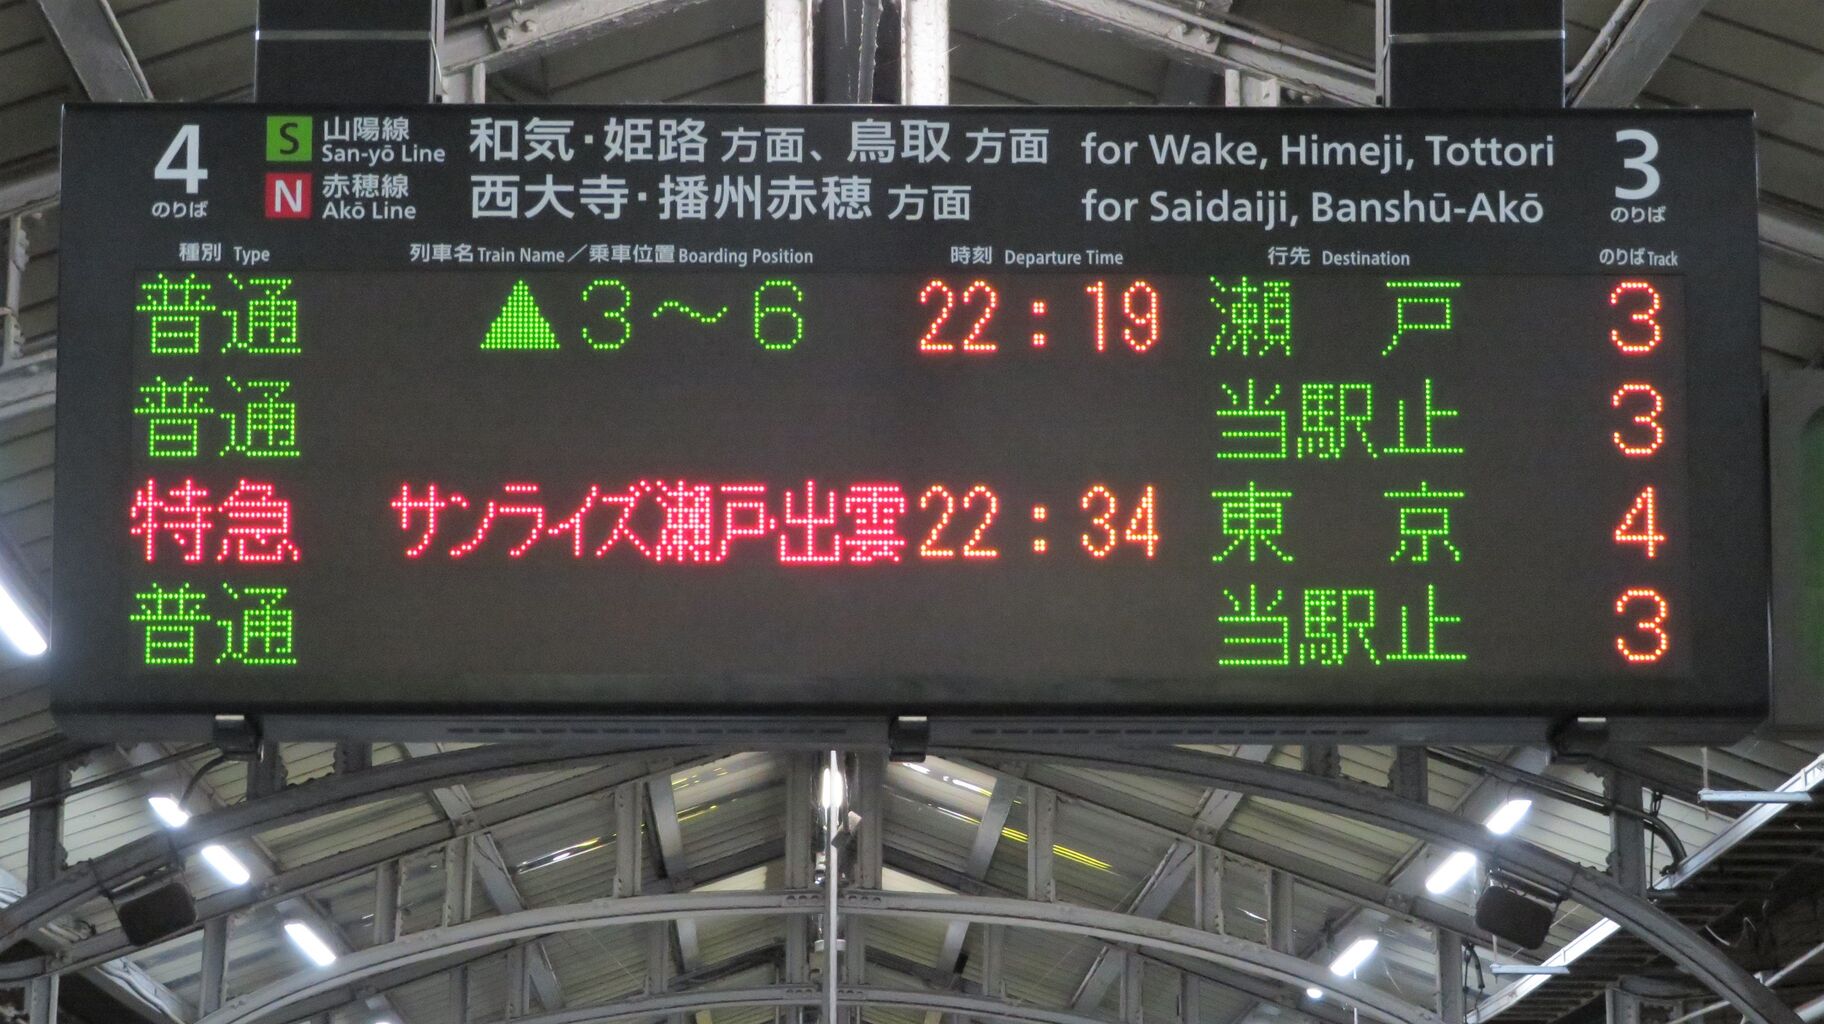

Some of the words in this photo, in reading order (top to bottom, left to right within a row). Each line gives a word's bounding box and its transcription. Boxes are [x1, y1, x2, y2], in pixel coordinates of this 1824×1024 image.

[280, 123, 299, 155] S
[324, 117, 409, 141] 山陽線
[154, 125, 208, 194] 4
[323, 145, 394, 166] San-yō
[402, 144, 445, 162] Line
[1081, 132, 1138, 164] for
[1149, 133, 1267, 169] Wake,
[1282, 134, 1413, 174] Himeji,
[1425, 135, 1553, 166] Tottori
[1615, 129, 1660, 200] 3
[274, 179, 303, 212] N
[323, 174, 408, 198] 赤穂線
[152, 201, 208, 218] のりば
[323, 200, 365, 219] Akō
[373, 201, 416, 219] Line
[1082, 189, 1138, 221] for
[1150, 190, 1298, 230] Saidaiji,
[1313, 190, 1543, 223] Banshū-Akō
[1611, 206, 1666, 222] のりば
[179, 243, 221, 261] 種別
[234, 247, 270, 265] Type
[410, 243, 473, 262] 列車名
[478, 248, 514, 262] Train
[679, 248, 747, 267] Boarding
[753, 249, 813, 263] Position
[951, 246, 992, 264] 時刻
[1005, 250, 1081, 268] Departure
[1086, 250, 1123, 264] Time
[1268, 247, 1310, 265] 行先
[1323, 251, 1409, 265] Destination
[1600, 248, 1645, 265] のりば
[1647, 251, 1678, 266] Track
[136, 273, 301, 353] 普通
[1609, 281, 1662, 354] 3
[134, 376, 300, 457] 普通
[1216, 378, 1463, 458] 当駅止
[1612, 383, 1664, 457] 3
[130, 479, 300, 562] 特急
[1614, 486, 1666, 558] 4
[130, 583, 296, 664] 普通
[1218, 584, 1467, 665] 当駅止
[1615, 588, 1668, 663] 3
